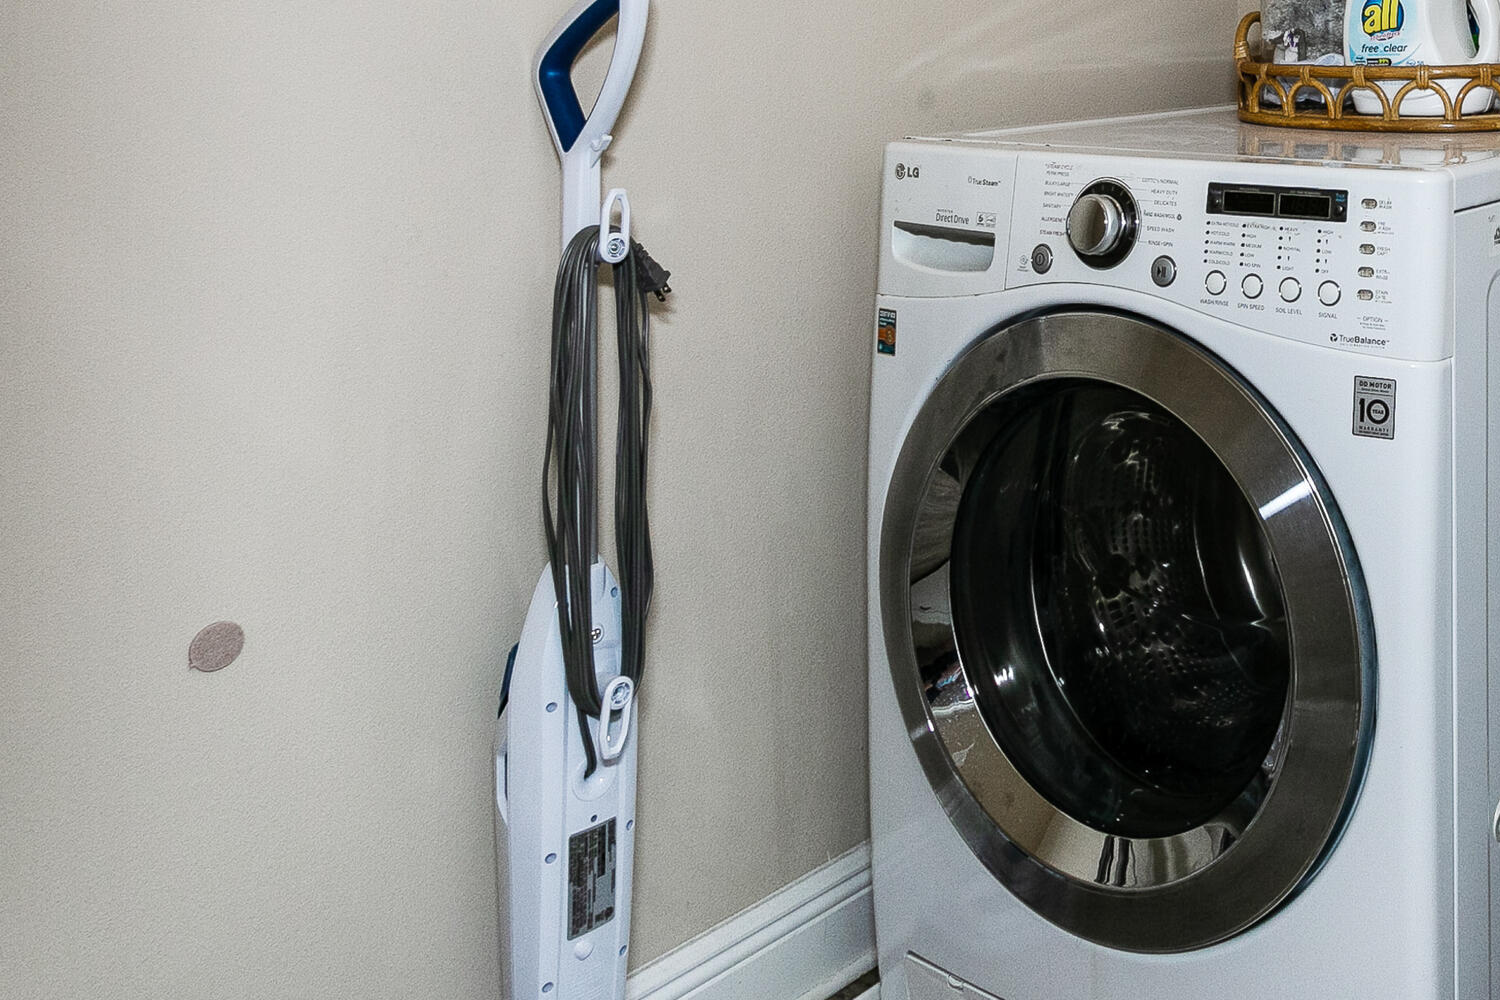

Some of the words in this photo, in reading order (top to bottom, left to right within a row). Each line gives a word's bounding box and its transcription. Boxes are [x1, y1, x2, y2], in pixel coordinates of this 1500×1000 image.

[1361, 44, 1379, 53] free
[1384, 43, 1408, 53] clear
[907, 167, 919, 178] LG
[936, 213, 953, 222] Direct
[954, 215, 969, 224] Drive
[1359, 398, 1390, 424] 10
